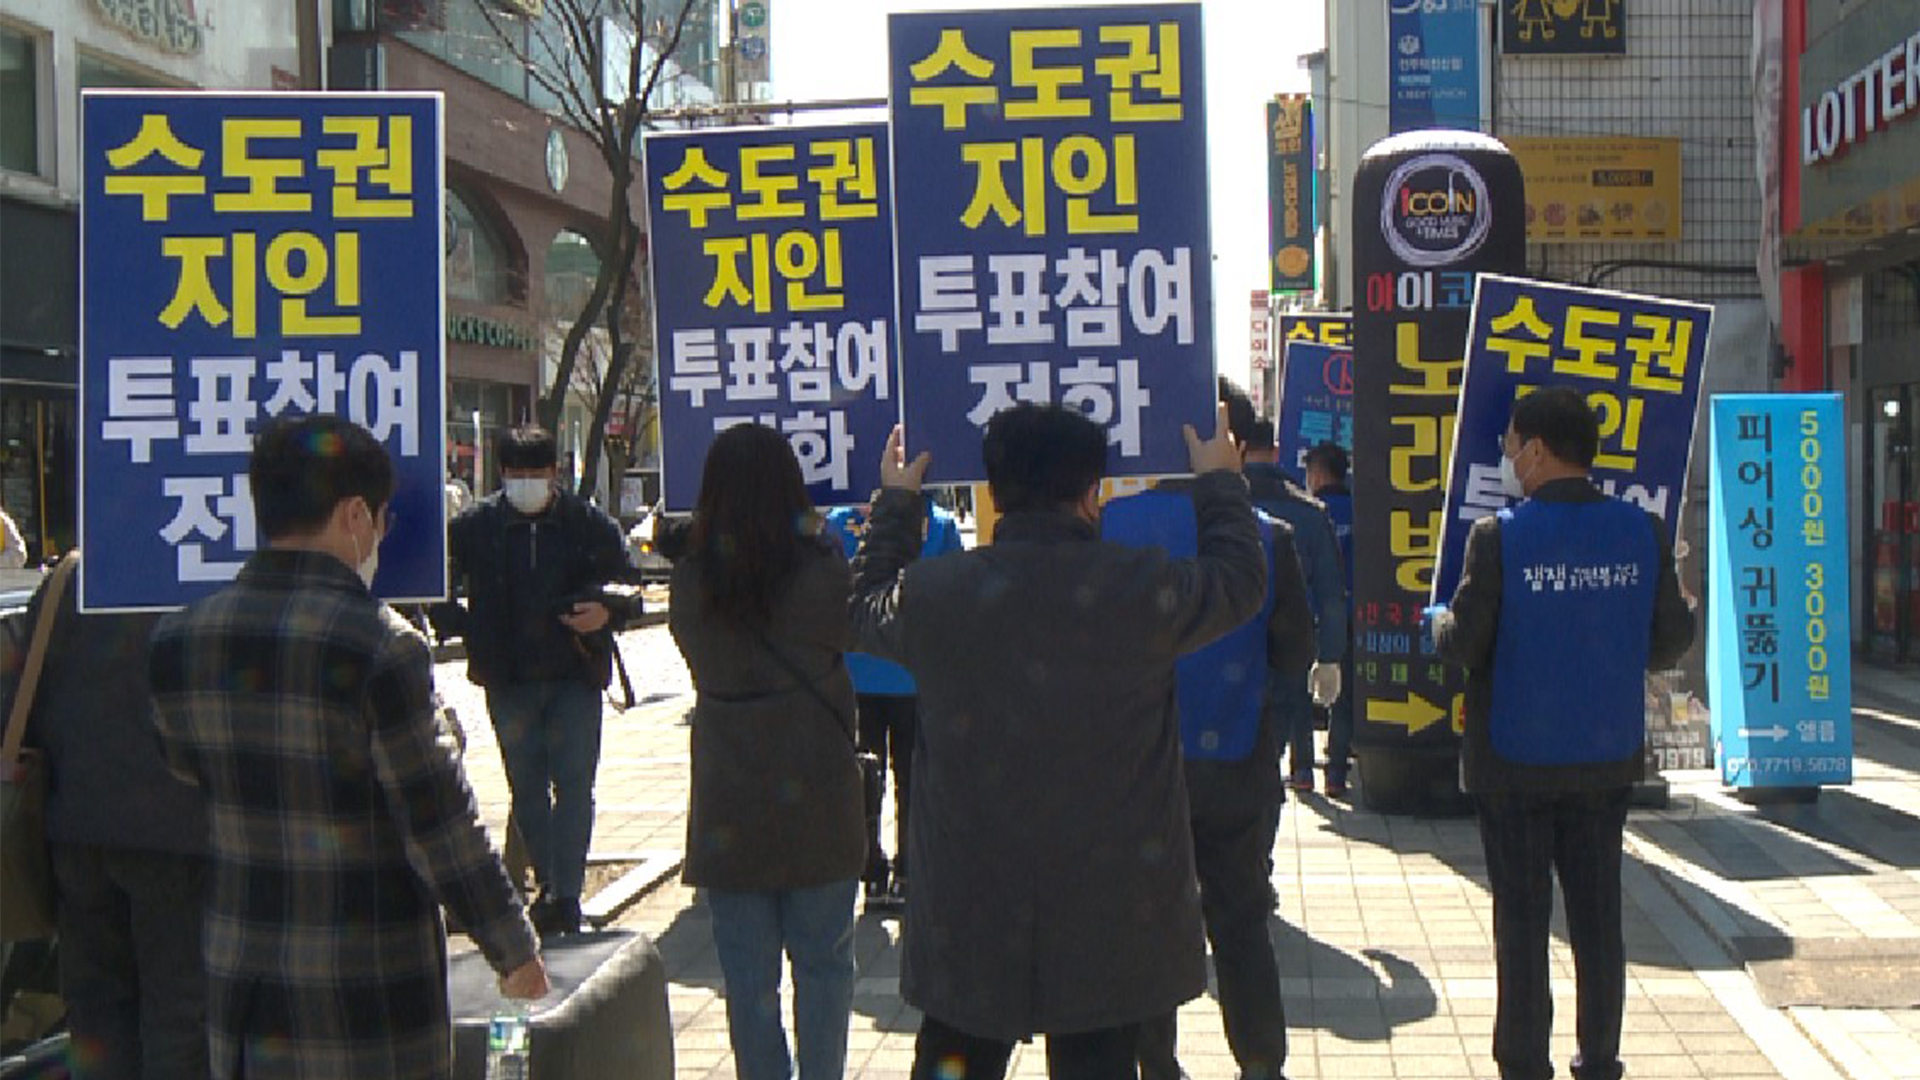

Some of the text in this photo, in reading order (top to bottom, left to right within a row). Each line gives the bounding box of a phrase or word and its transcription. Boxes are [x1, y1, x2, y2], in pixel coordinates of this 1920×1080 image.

[909, 22, 1184, 130] 수도권
[103, 113, 414, 222] 수도권
[661, 137, 879, 228] 수도권
[959, 132, 1140, 237] 지인
[157, 231, 362, 339] 지인
[702, 230, 845, 313] 지인
[914, 246, 1195, 353] 투표참여
[1366, 270, 1472, 312] 아이코
[669, 319, 891, 407] 투표참여
[1484, 296, 1693, 394] 수도권
[713, 410, 855, 490] 화
[158, 473, 258, 583] 전
[1737, 412, 1781, 704] 피어싱 귀뚫기
[1800, 410, 1832, 701] 5000원 3000원
